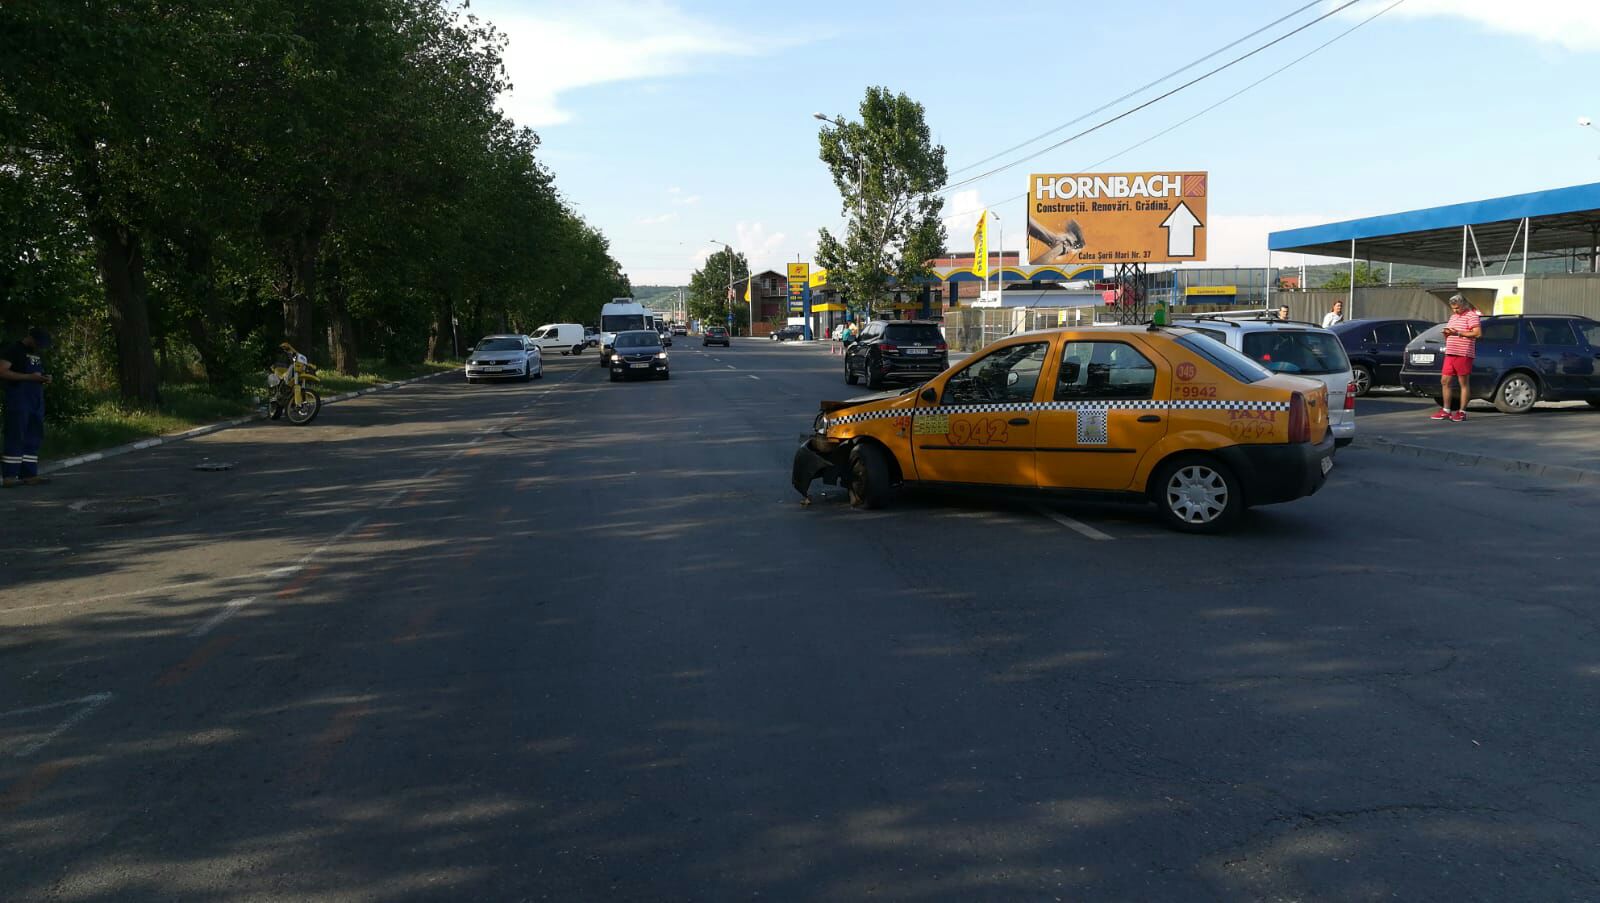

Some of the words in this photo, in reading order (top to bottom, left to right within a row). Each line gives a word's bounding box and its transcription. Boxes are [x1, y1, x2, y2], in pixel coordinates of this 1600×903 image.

[1036, 175, 1181, 200] HORNBACH
[1036, 203, 1089, 215] Construcții.
[1091, 200, 1132, 212] Renovări.
[1135, 199, 1172, 211] Grădină.
[1078, 252, 1096, 260] Calea
[1114, 251, 1130, 259] Mari
[1143, 250, 1151, 259] 37
[1182, 386, 1217, 398] 9942
[1228, 409, 1278, 422] TAXI
[945, 418, 1008, 445] 942
